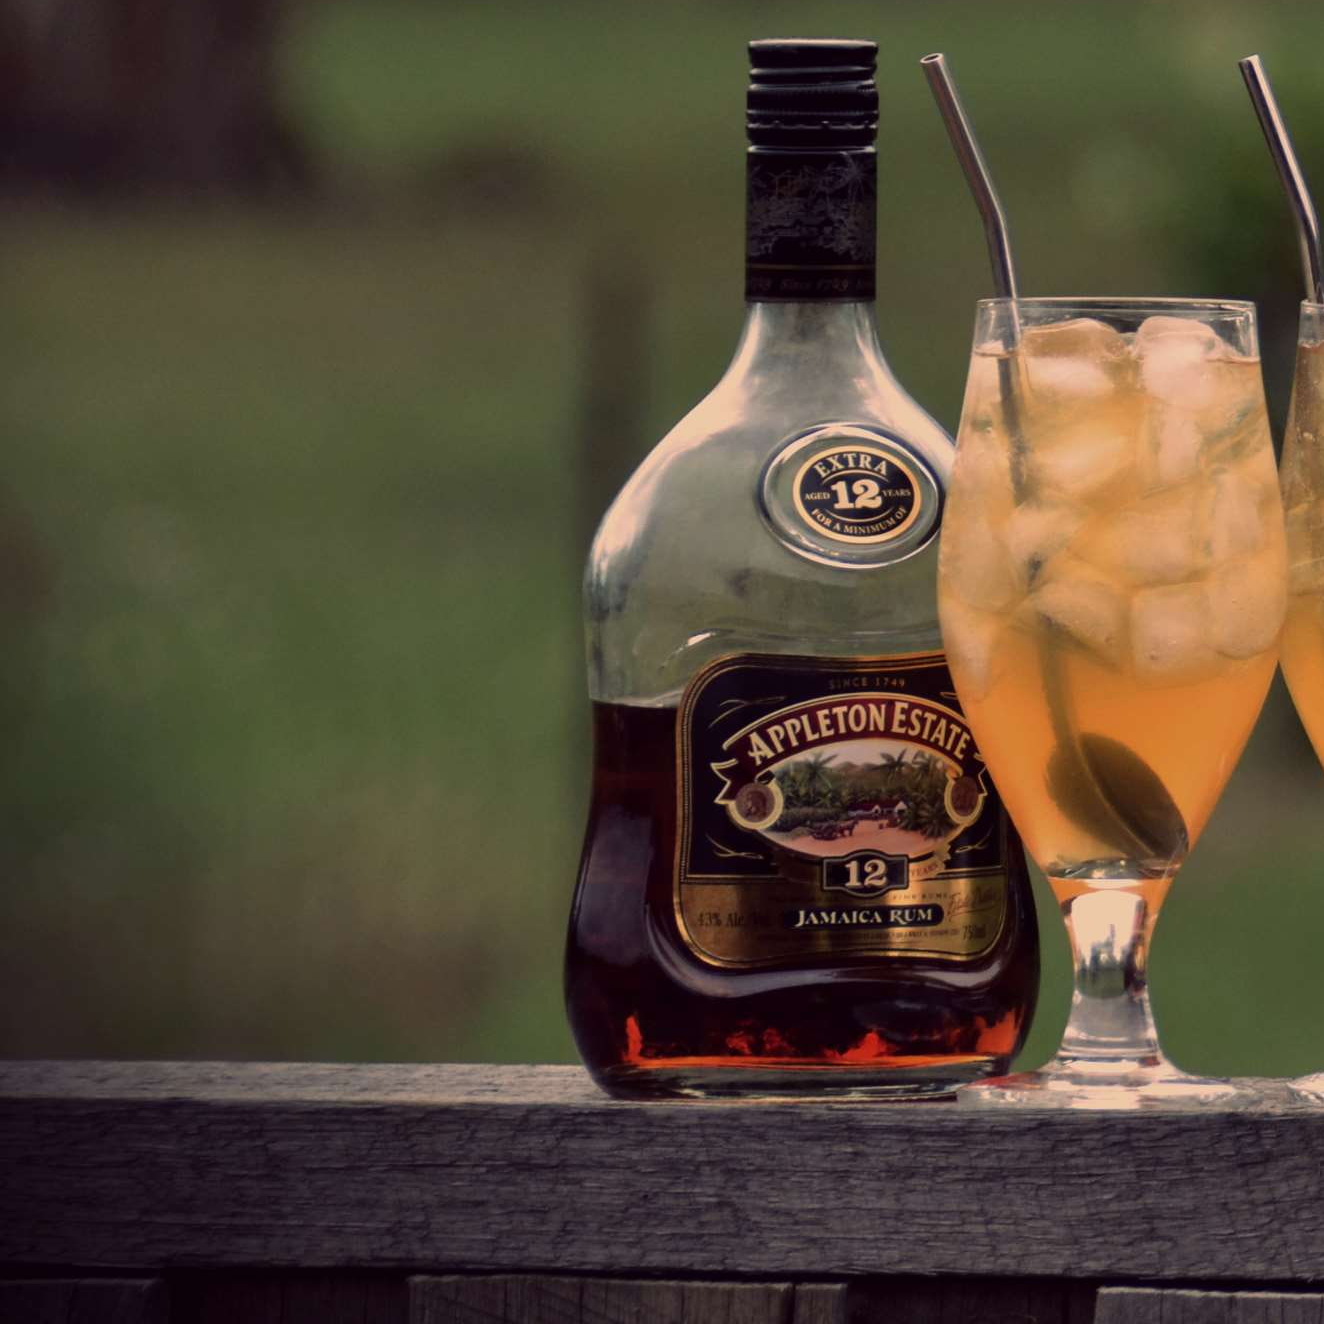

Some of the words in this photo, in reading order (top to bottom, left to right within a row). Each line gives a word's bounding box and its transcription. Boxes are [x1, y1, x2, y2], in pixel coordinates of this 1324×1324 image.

[813, 453, 888, 478] EXTRA
[804, 492, 830, 500] AGED
[831, 479, 883, 509] 12
[882, 489, 911, 497] YEARS
[811, 508, 831, 527] FOR
[835, 523, 841, 531] A
[844, 519, 897, 535] MINIMUM
[895, 506, 907, 520] OF
[829, 677, 868, 689] SINCE
[875, 676, 905, 687] 1749
[748, 703, 886, 766] APPLETON
[891, 700, 971, 760] ESTATE
[844, 859, 888, 888] 12
[795, 908, 882, 927] JAMAICA
[889, 908, 933, 925] RUM
